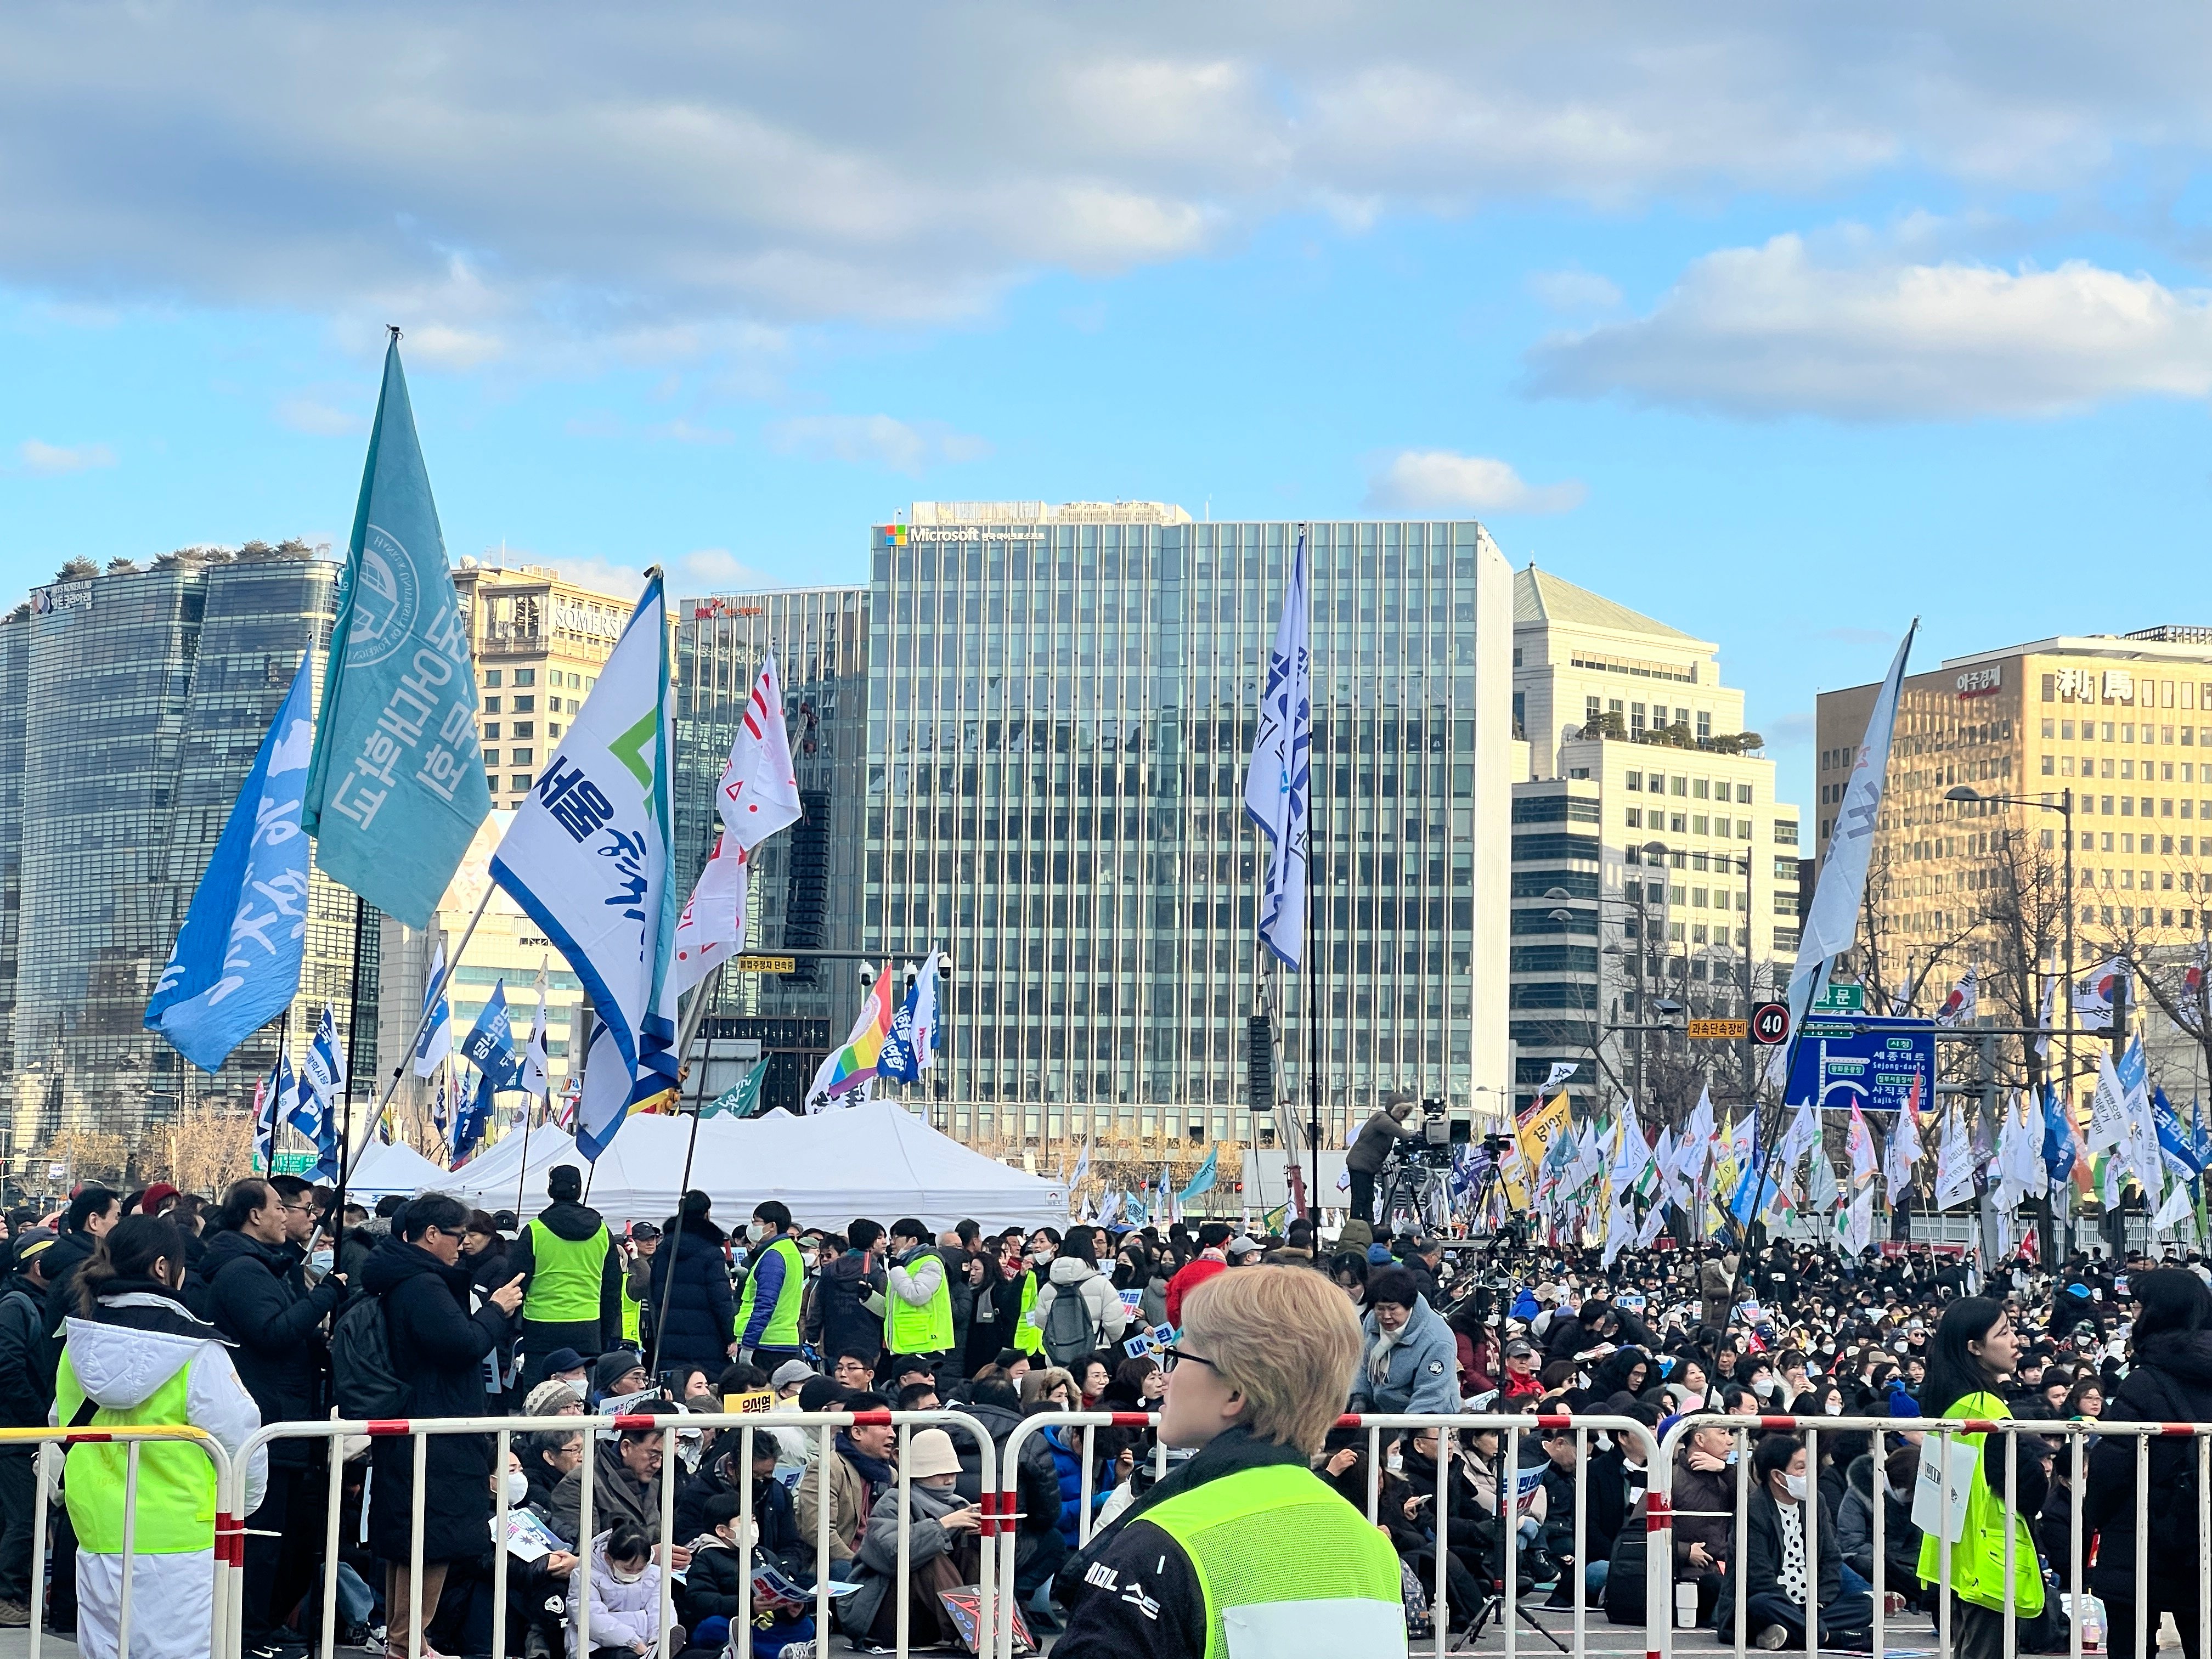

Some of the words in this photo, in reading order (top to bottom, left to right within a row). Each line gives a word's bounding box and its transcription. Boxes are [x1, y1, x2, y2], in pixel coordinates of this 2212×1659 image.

[911, 527, 979, 542] Microsoft
[555, 606, 628, 639] SOMERSE
[1956, 665, 2001, 692] 아주경제
[2056, 667, 2134, 701] 利馬
[532, 755, 614, 844] 서울
[1691, 1022, 1746, 1037] 과속단속장비
[1762, 1014, 1782, 1034] 40
[1890, 1040, 1910, 1048] 시청
[1873, 1051, 1926, 1061] 세종대로
[1873, 1062, 1926, 1071] Sejong-daeo
[1872, 1086, 1927, 1097] 사직로길
